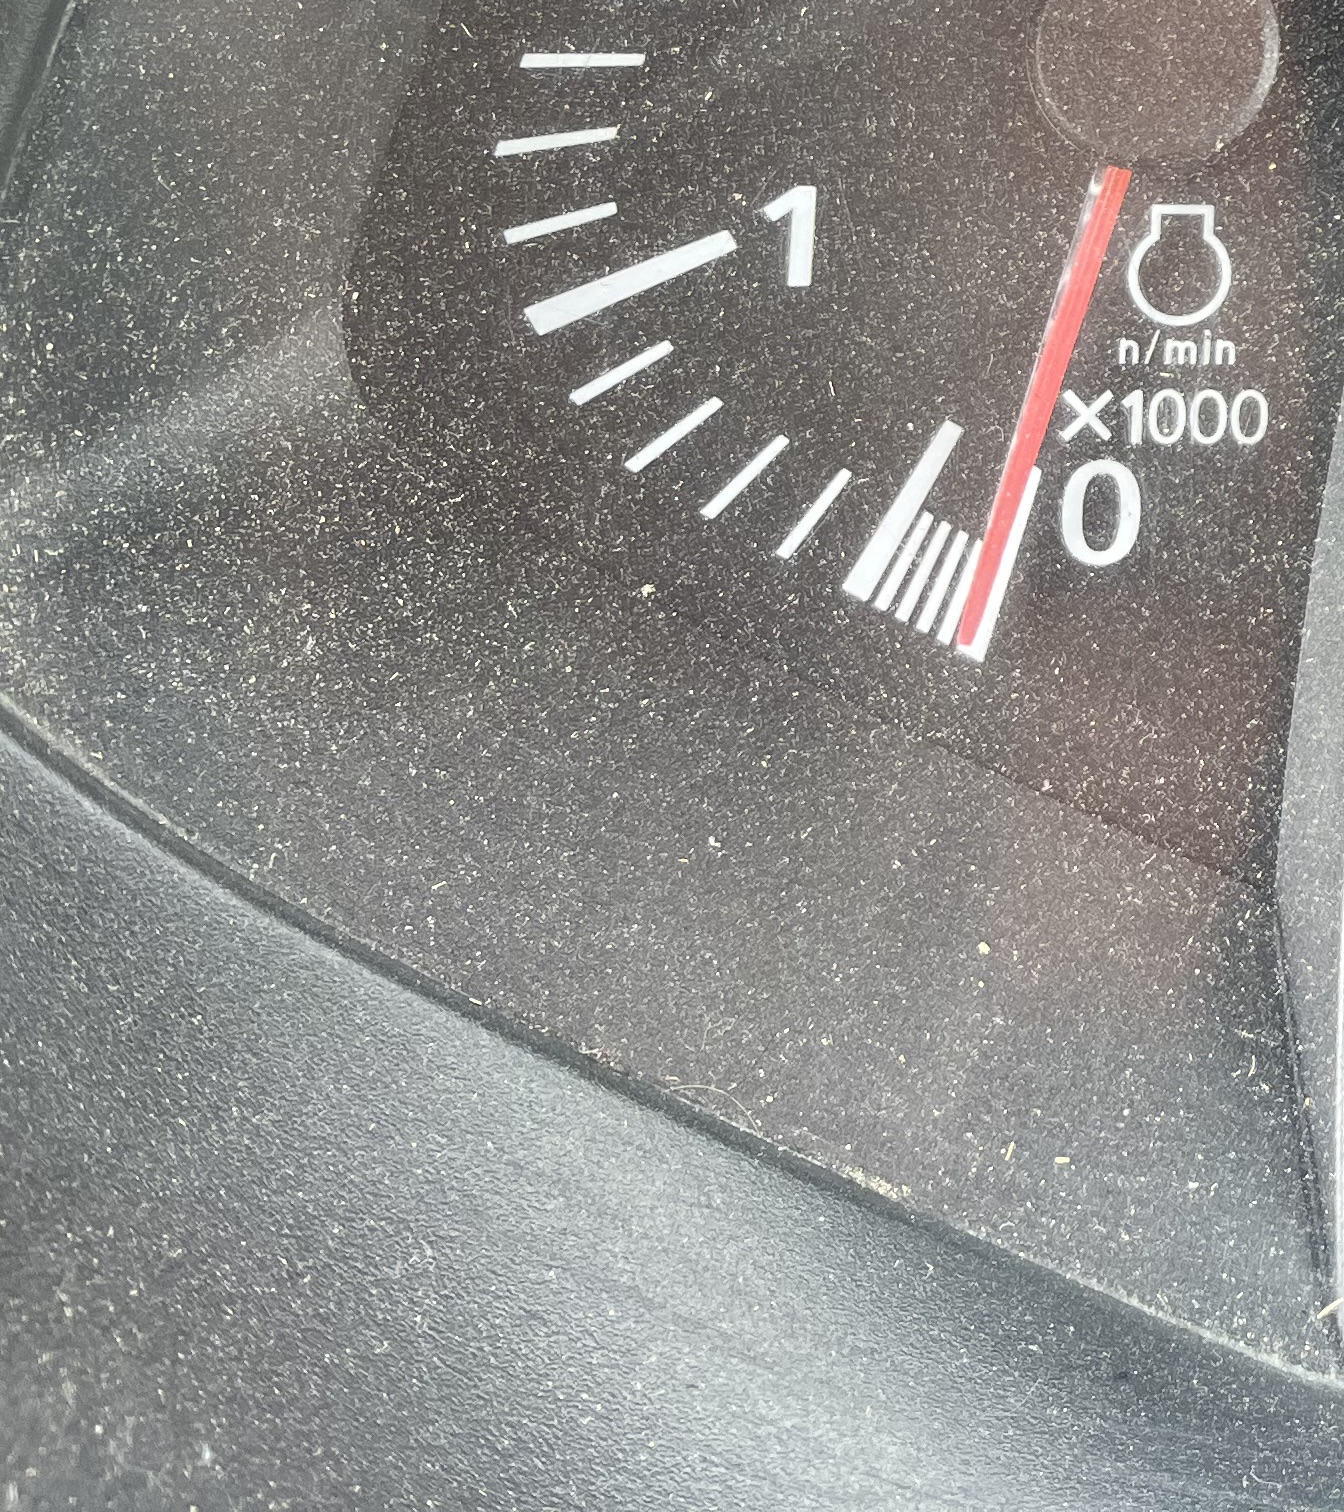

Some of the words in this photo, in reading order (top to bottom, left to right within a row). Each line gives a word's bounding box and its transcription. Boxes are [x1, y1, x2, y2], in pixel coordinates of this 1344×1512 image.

[763, 186, 817, 287] 1
[1118, 329, 1236, 366] n/min
[1061, 459, 1141, 567] 0
